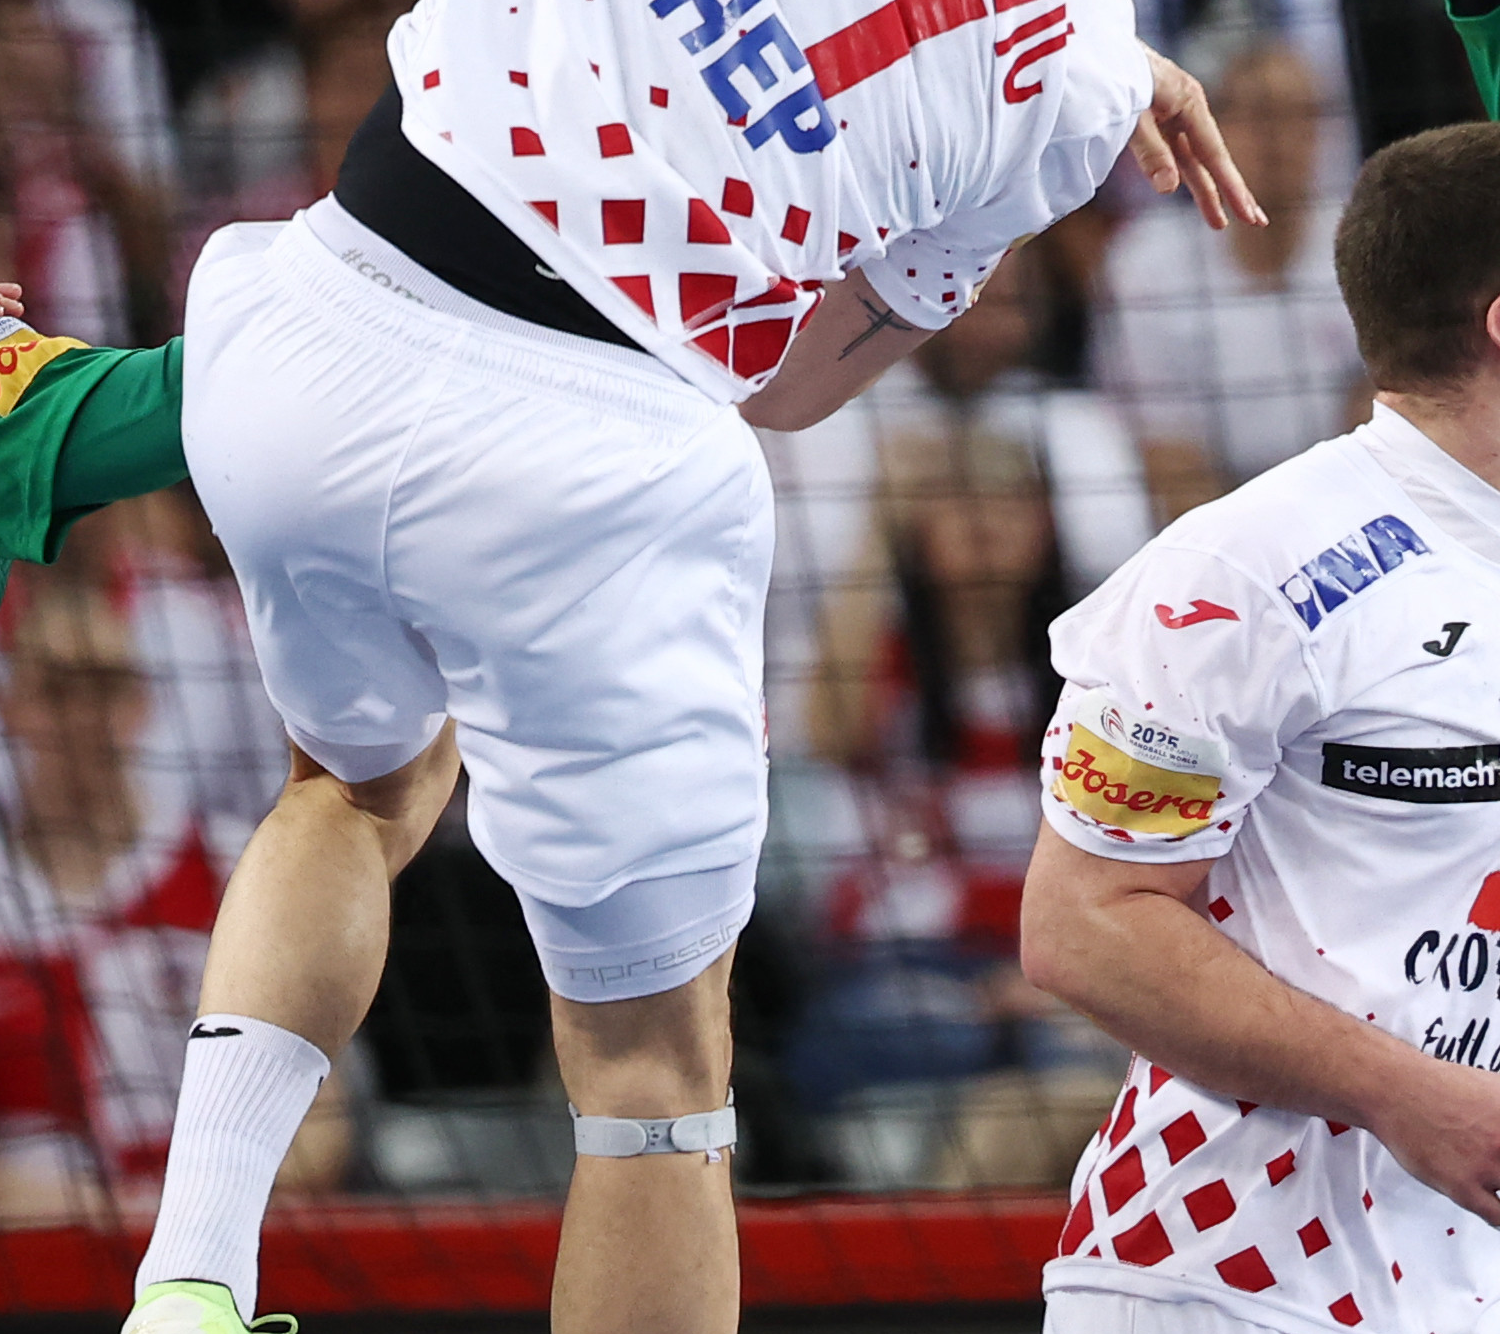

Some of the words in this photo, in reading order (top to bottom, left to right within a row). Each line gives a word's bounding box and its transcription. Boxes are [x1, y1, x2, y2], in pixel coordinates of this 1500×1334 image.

[1131, 723, 1180, 749] 2025
[1063, 749, 1215, 820] Josera
[1342, 759, 1496, 788] telemach
